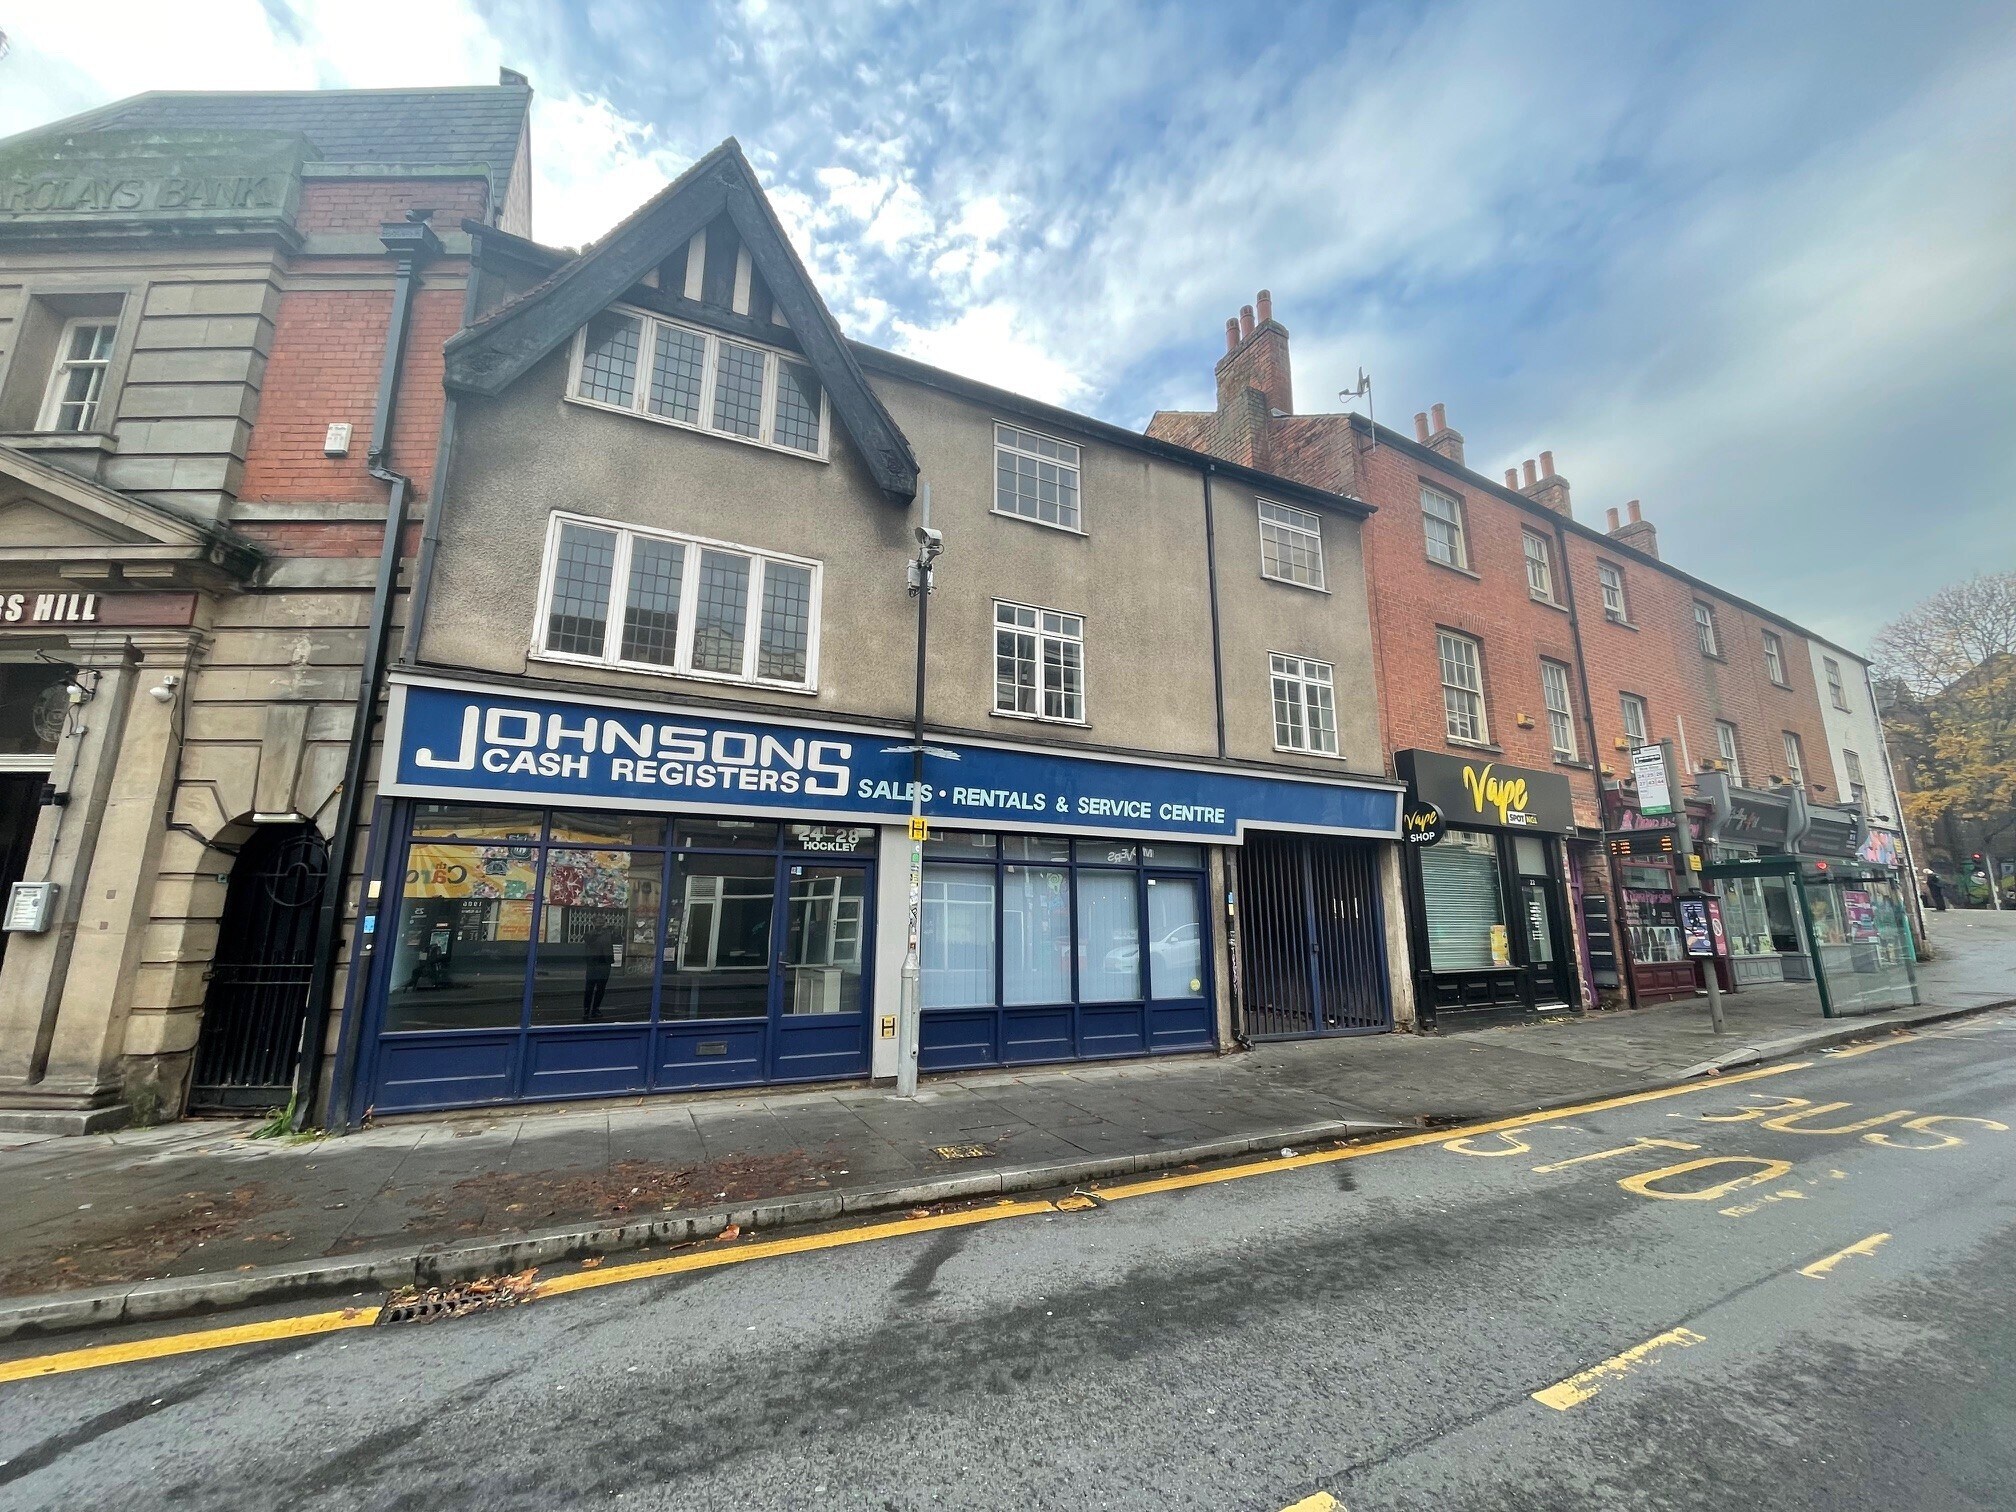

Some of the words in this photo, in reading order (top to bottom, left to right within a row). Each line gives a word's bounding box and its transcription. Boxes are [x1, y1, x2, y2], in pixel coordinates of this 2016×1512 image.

[158, 177, 272, 209] BANK
[0, 594, 25, 621] S
[33, 594, 96, 621] HILL
[415, 705, 853, 797] JOHNSONS
[481, 748, 589, 779] CASH
[611, 758, 801, 792] REGISTERS
[857, 778, 934, 803] SALES
[952, 786, 1046, 812] RENTALS
[1055, 796, 1069, 812] &
[1077, 797, 1152, 819] SERVICE
[1159, 802, 1226, 824] CENTRE
[1462, 763, 1529, 825] Vape
[912, 820, 924, 838] H
[1404, 810, 1438, 832] Vape
[1509, 813, 1525, 823] SPOT
[803, 841, 857, 852] HOCKLEY
[1410, 831, 1436, 843] SHOP
